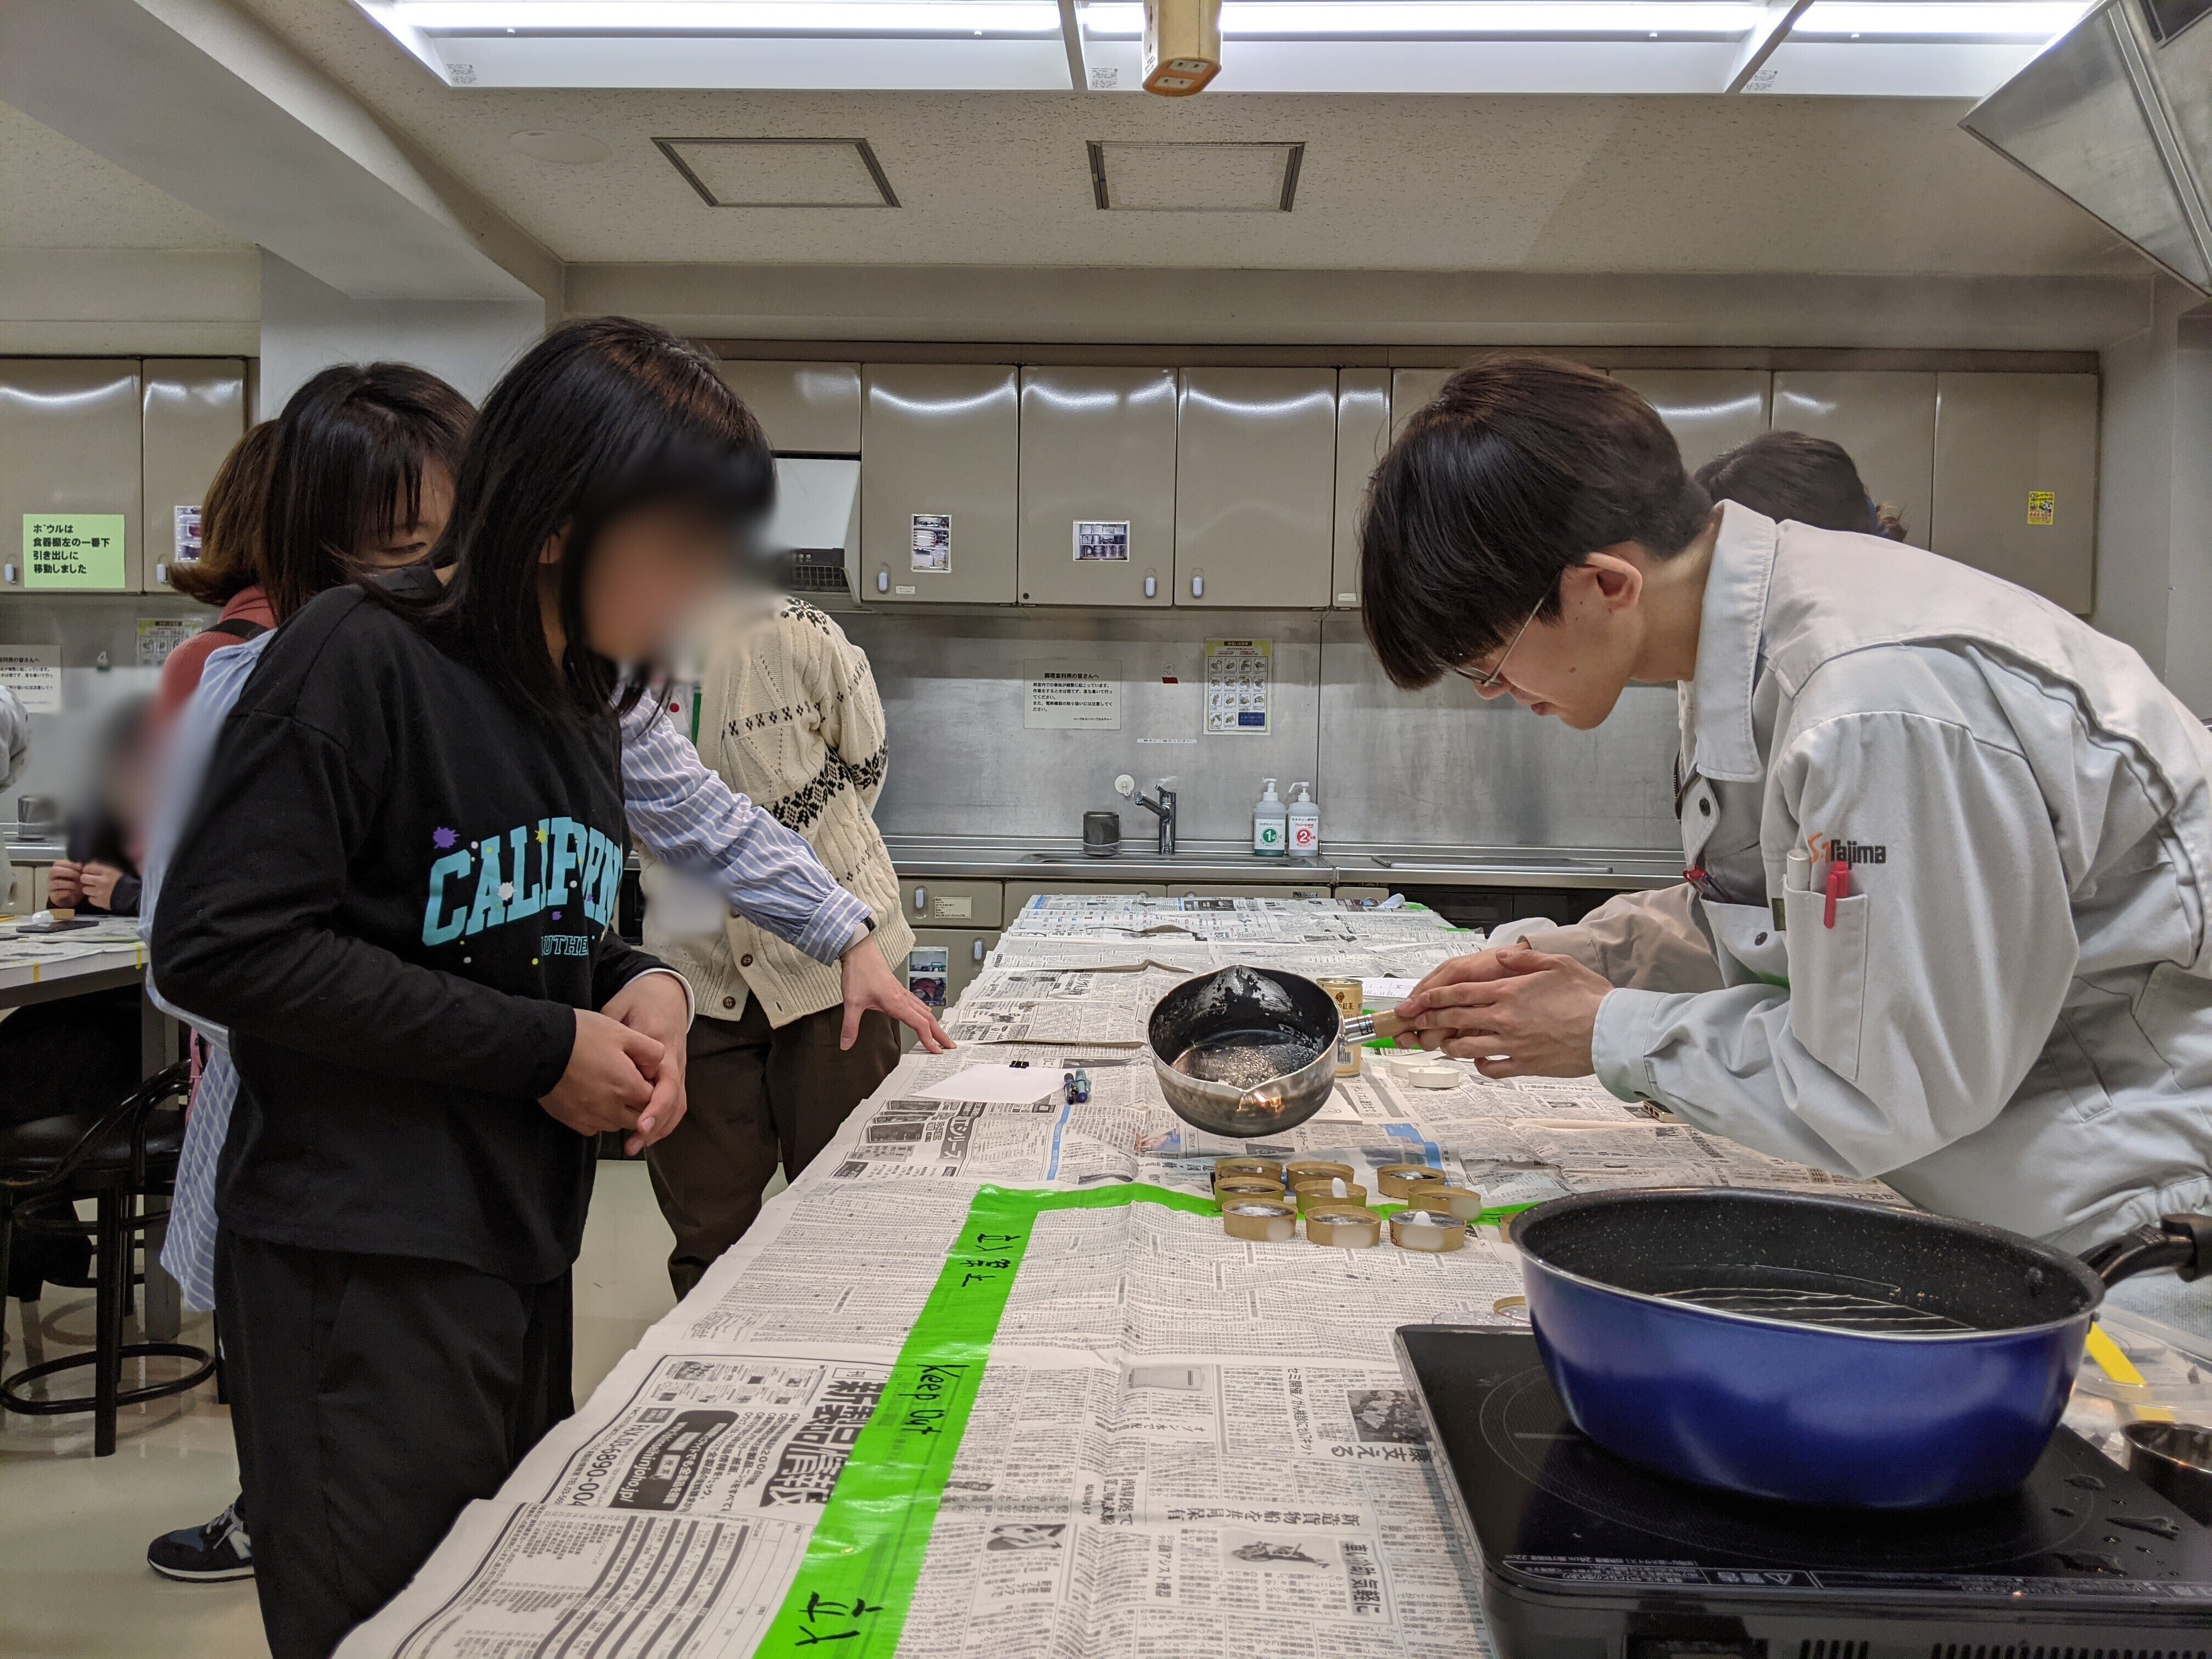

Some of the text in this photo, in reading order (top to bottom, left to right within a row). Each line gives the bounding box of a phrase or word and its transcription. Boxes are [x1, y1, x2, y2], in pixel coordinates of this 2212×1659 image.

[33, 537, 110, 548] 食器棚左の一番下
[33, 550, 79, 560] 引き出しに
[33, 564, 87, 574] 移動しました
[96, 651, 108, 665] 4
[1266, 830, 1271, 841] 1
[1299, 831, 1307, 843] 2
[541, 935, 589, 956] UTHE
[960, 1233, 1021, 1287] 立入禁止
[898, 1363, 970, 1435] Keep Out
[1166, 1507, 1361, 1527] 新造貨物船を共同保有
[794, 1590, 884, 1647] 立入
